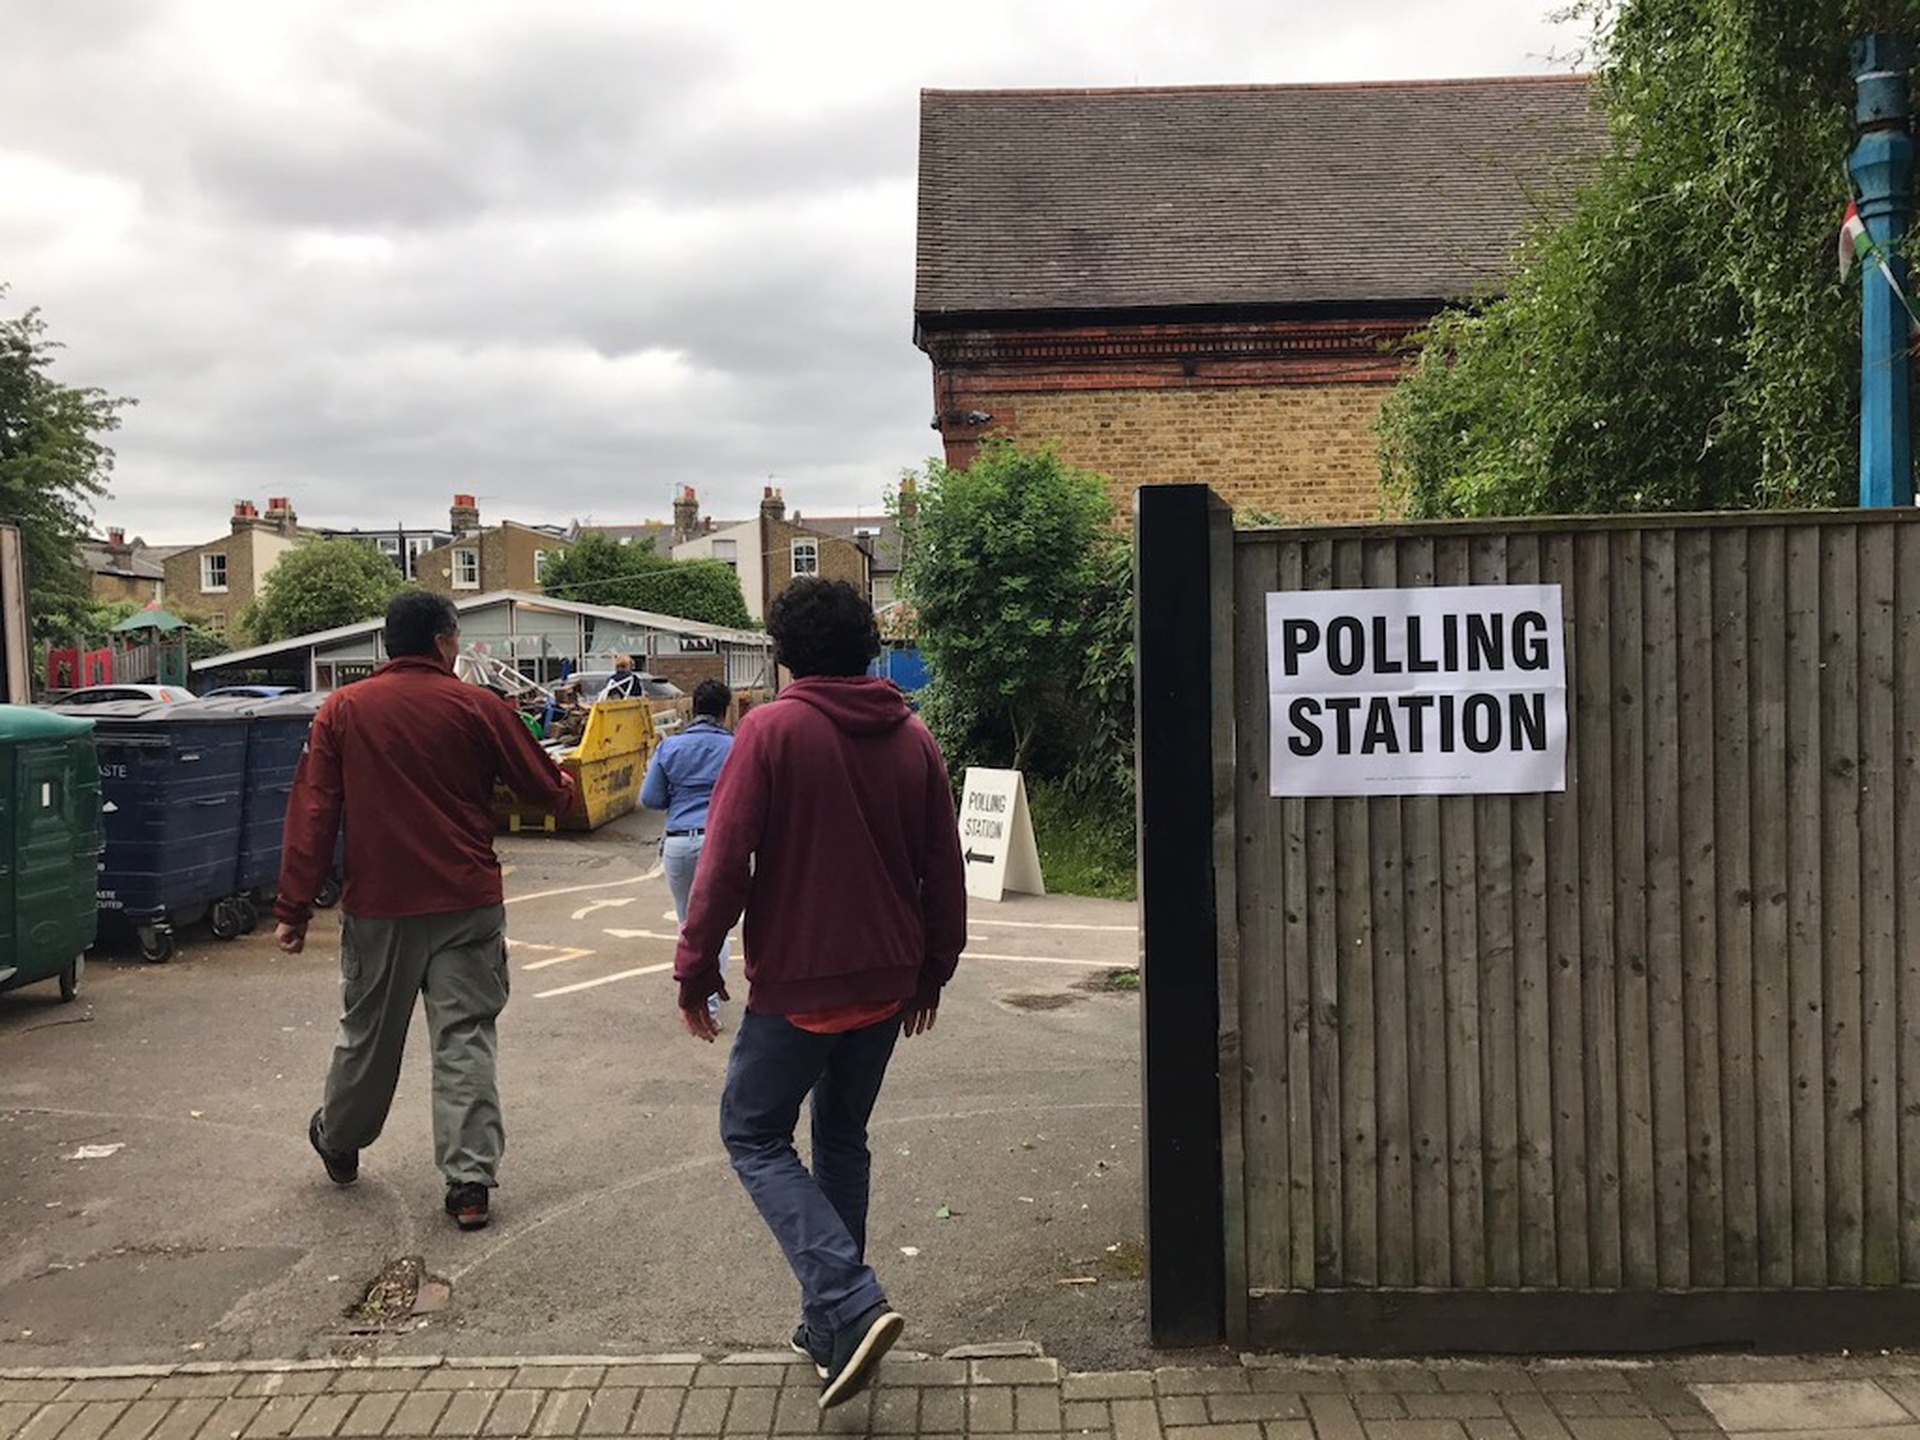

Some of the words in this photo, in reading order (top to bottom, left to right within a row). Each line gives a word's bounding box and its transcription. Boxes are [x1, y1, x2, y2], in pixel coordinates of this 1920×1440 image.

[1283, 611, 1549, 676] POLLING
[1287, 693, 1547, 757] STATION
[968, 791, 1007, 813] POLLING
[965, 818, 1004, 839] STATION
